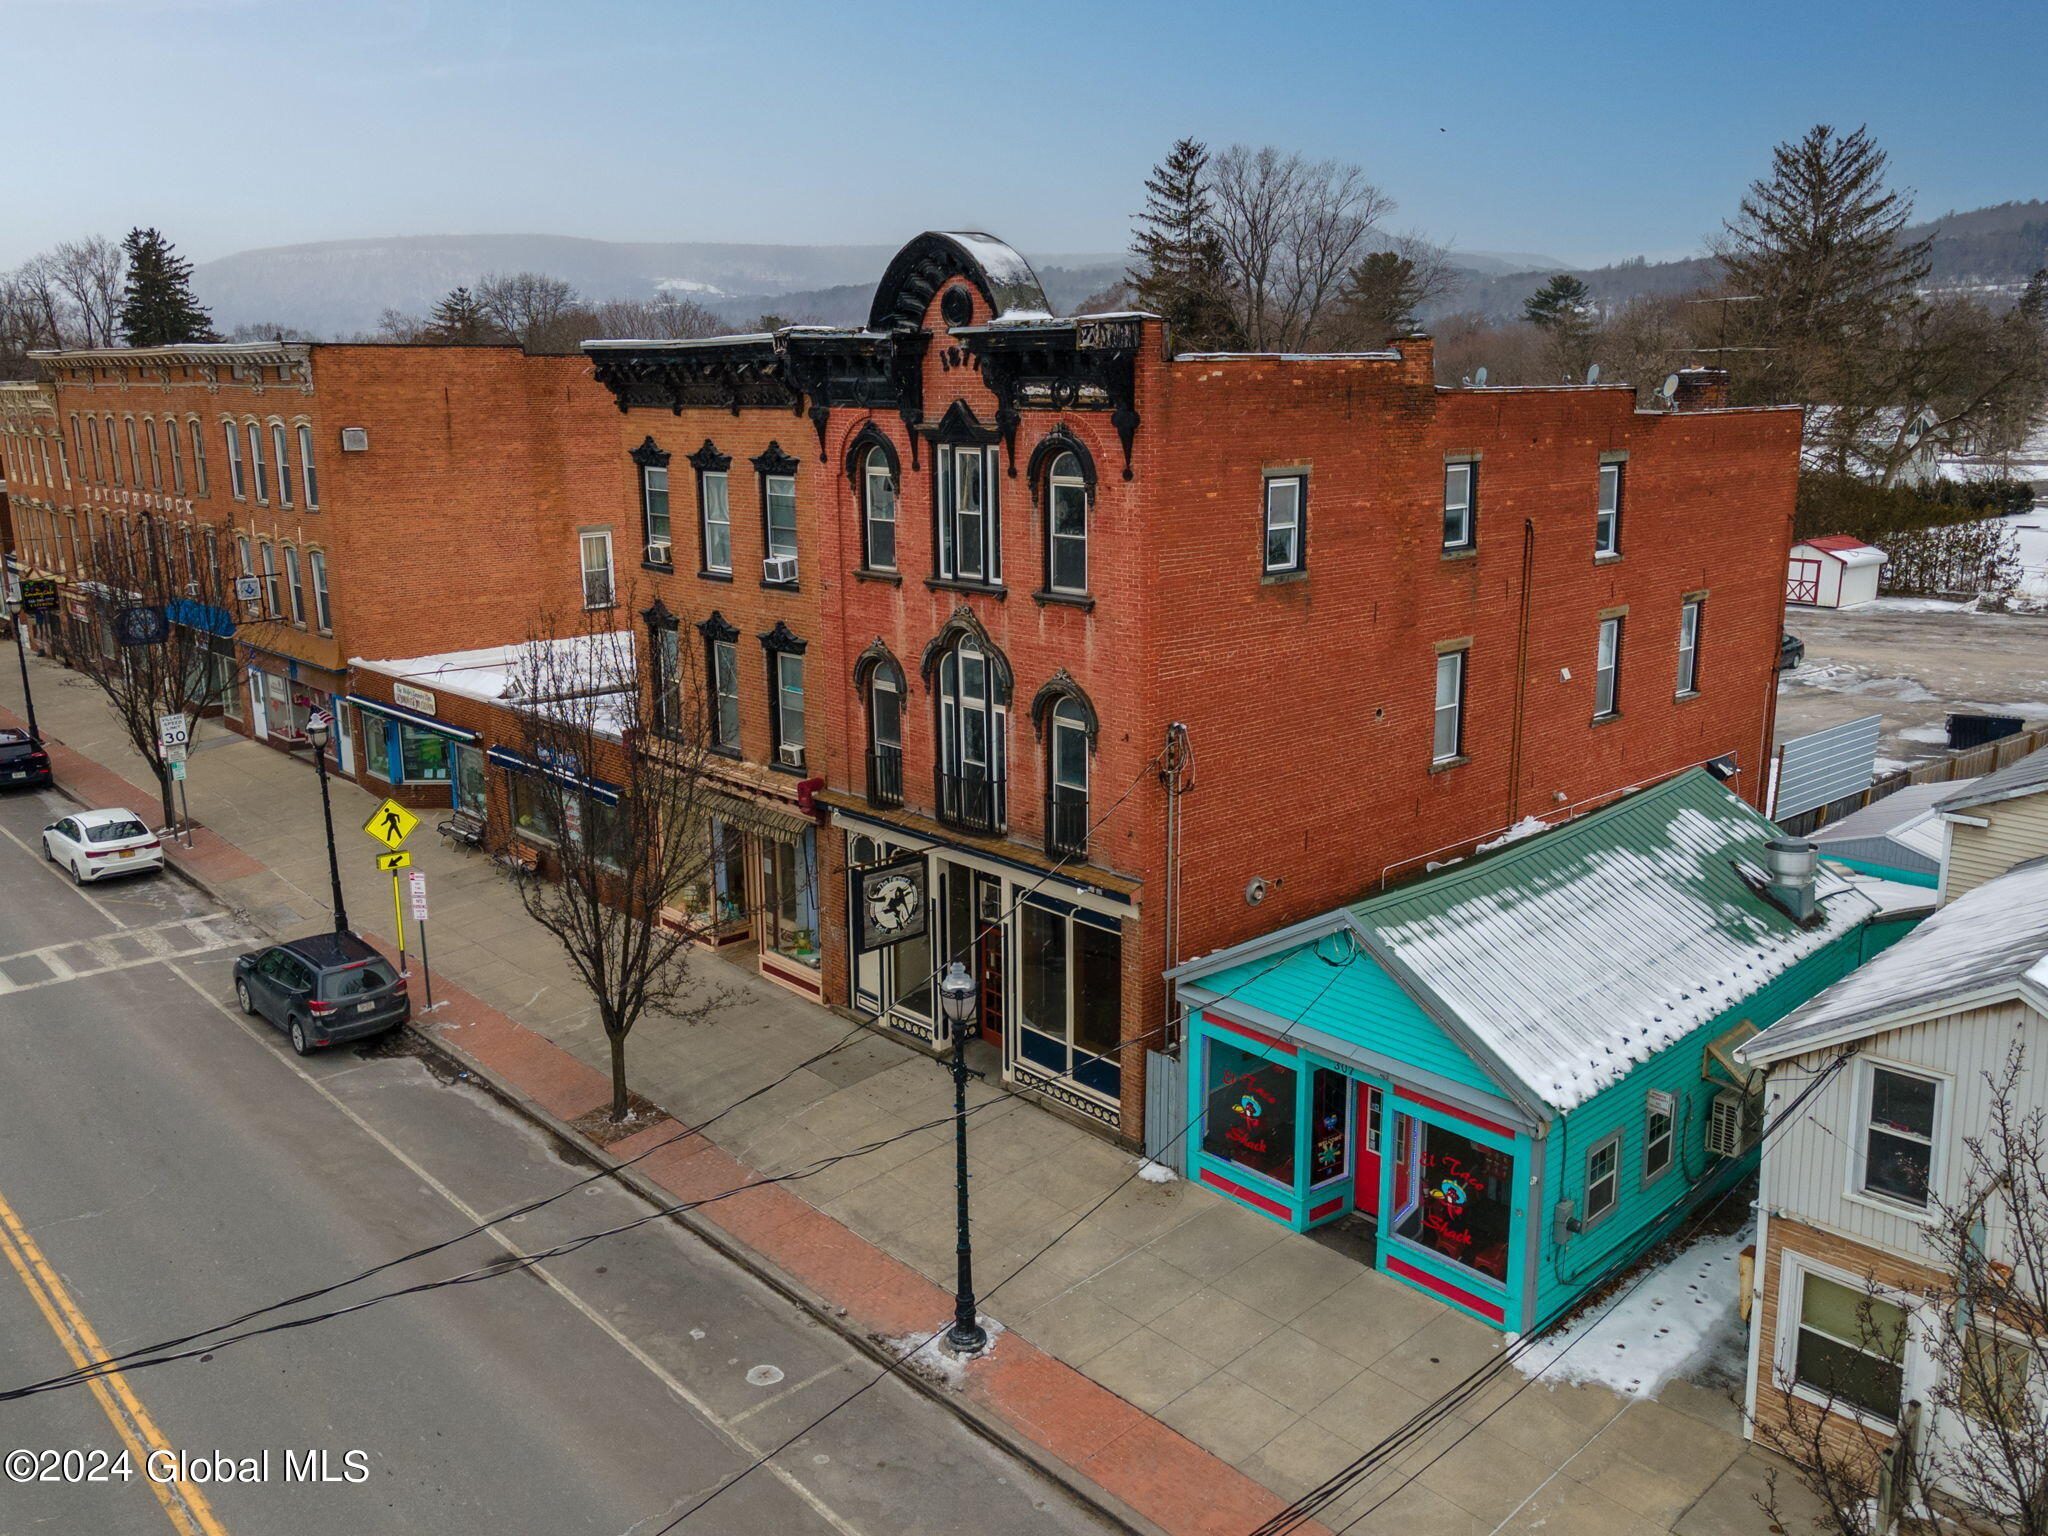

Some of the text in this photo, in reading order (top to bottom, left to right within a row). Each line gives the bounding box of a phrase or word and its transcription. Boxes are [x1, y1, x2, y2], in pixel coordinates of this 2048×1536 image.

[85, 486, 192, 515] TAYLOR BLOCK
[165, 730, 185, 743] 30
[1334, 1061, 1355, 1076] 307
[1222, 1070, 1276, 1104] El Taco
[1225, 1127, 1267, 1153] Shack
[1418, 1151, 1485, 1191] El Taco
[1420, 1215, 1473, 1245] Shack
